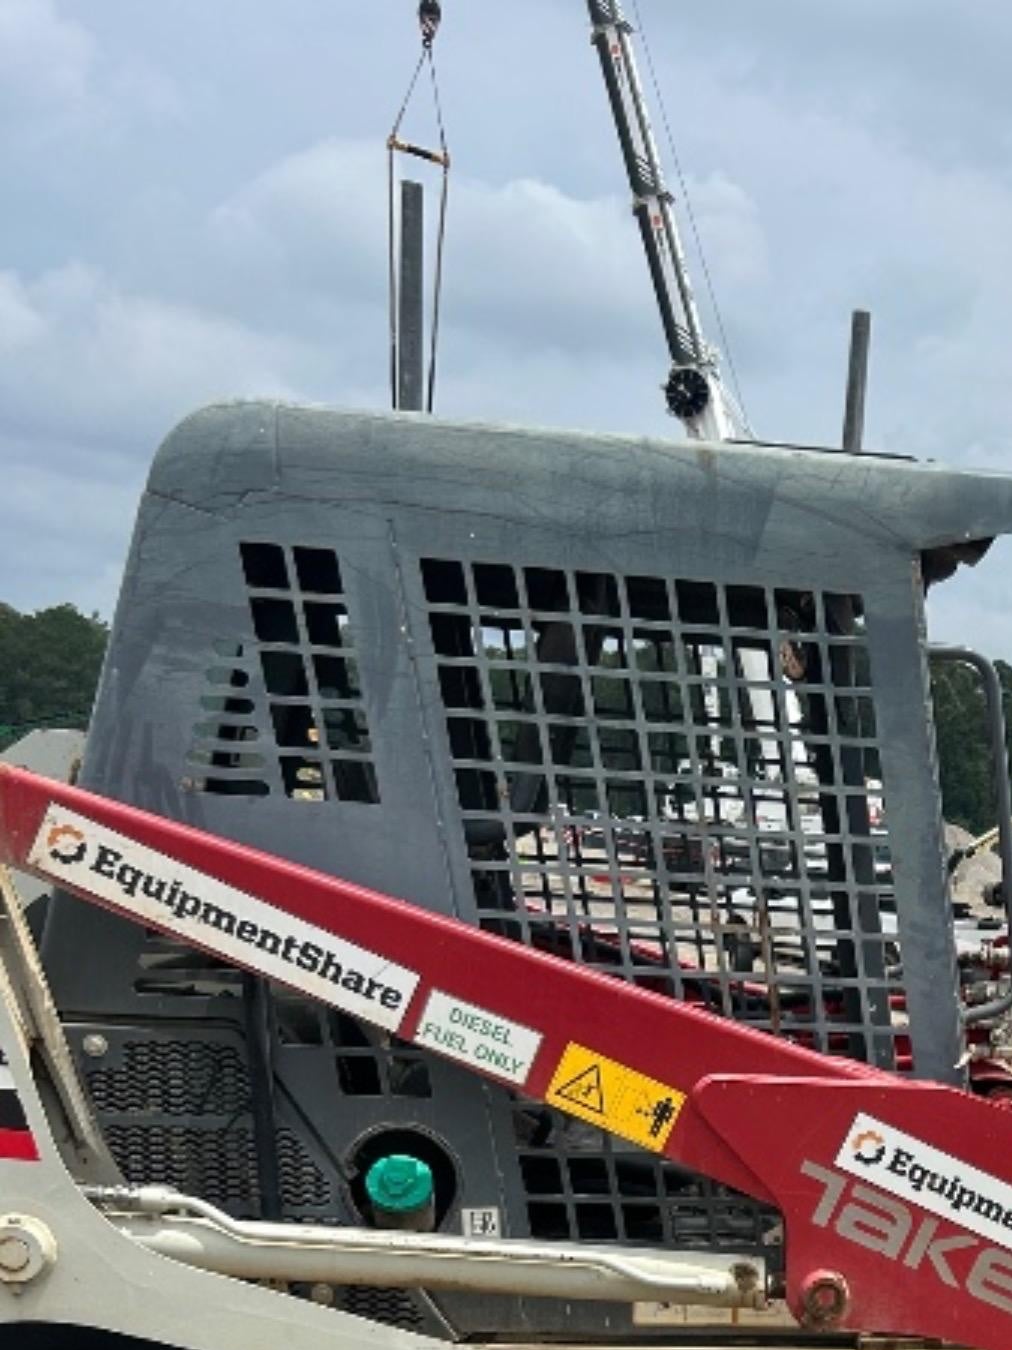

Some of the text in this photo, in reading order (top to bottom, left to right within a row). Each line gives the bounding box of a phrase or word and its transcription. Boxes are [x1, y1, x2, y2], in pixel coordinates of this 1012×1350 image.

[89, 844, 404, 1011] EquipmentShare
[422, 1022, 525, 1074] FUEL ONLY
[448, 1006, 513, 1047] DIESEL
